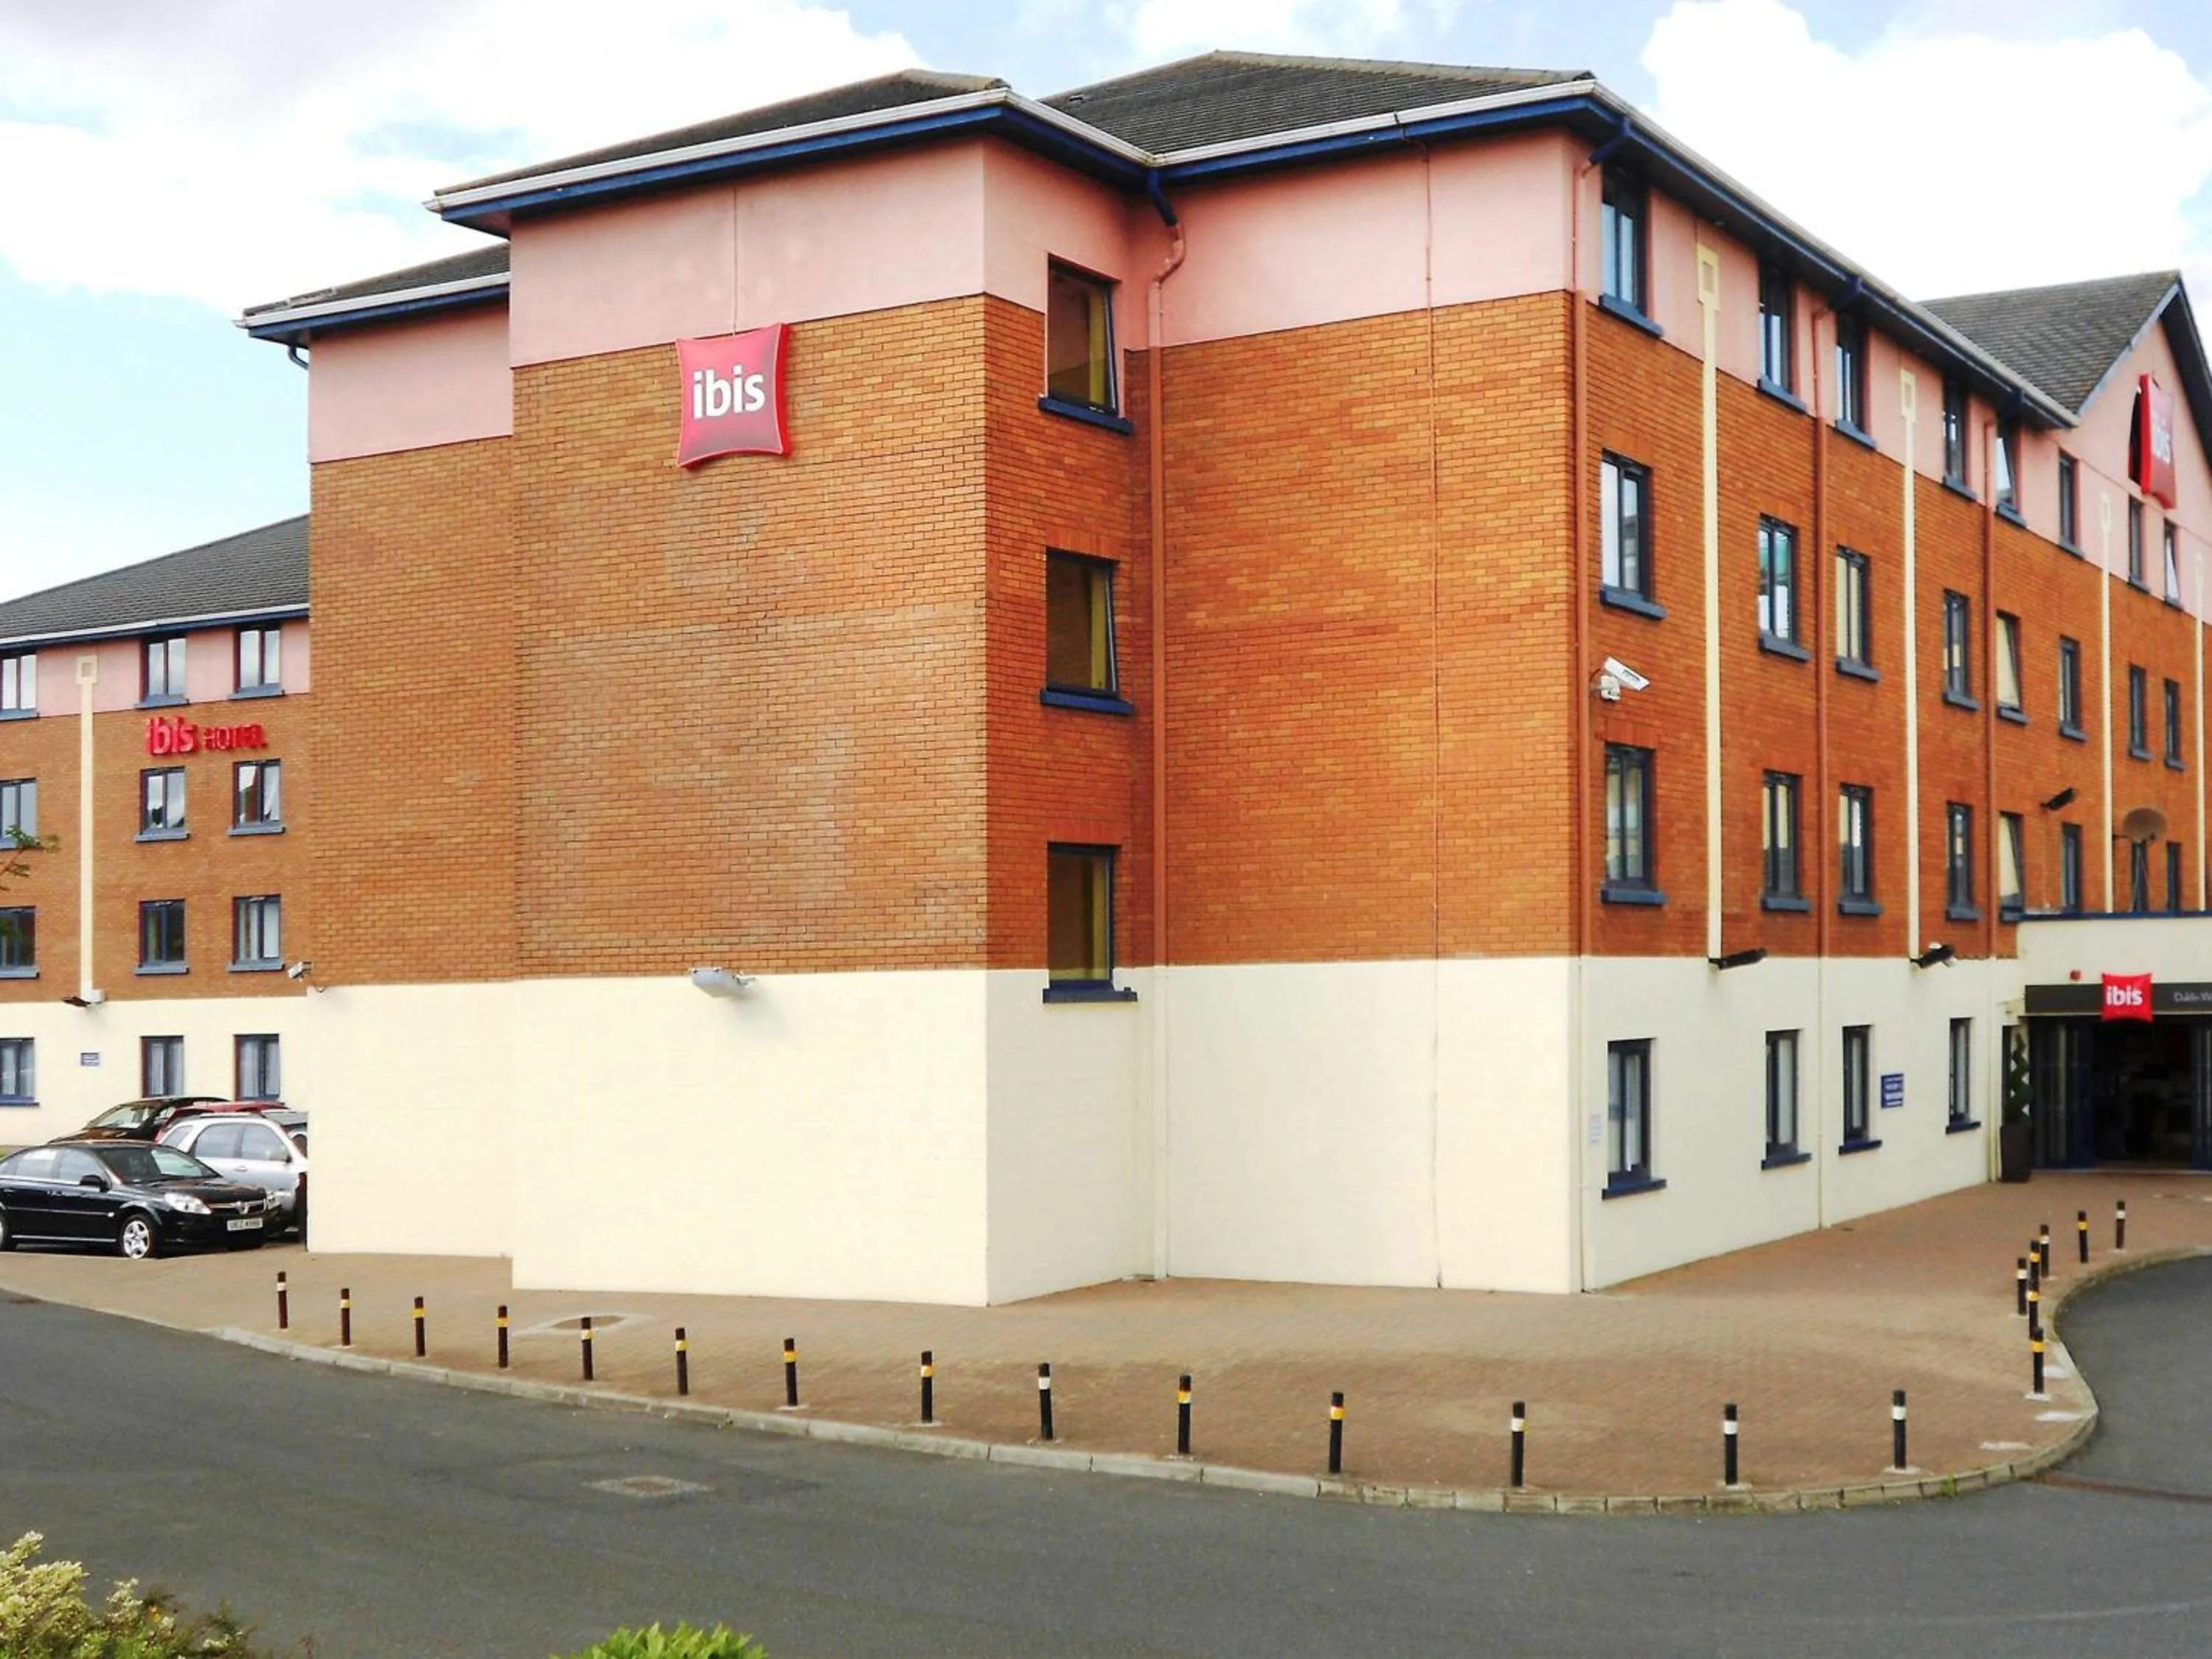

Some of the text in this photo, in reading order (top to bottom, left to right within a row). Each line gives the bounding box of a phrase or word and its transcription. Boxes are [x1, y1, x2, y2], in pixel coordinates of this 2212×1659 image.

[693, 364, 766, 420] ibis
[146, 715, 198, 756] ibis
[2106, 984, 2143, 1006] ibis
